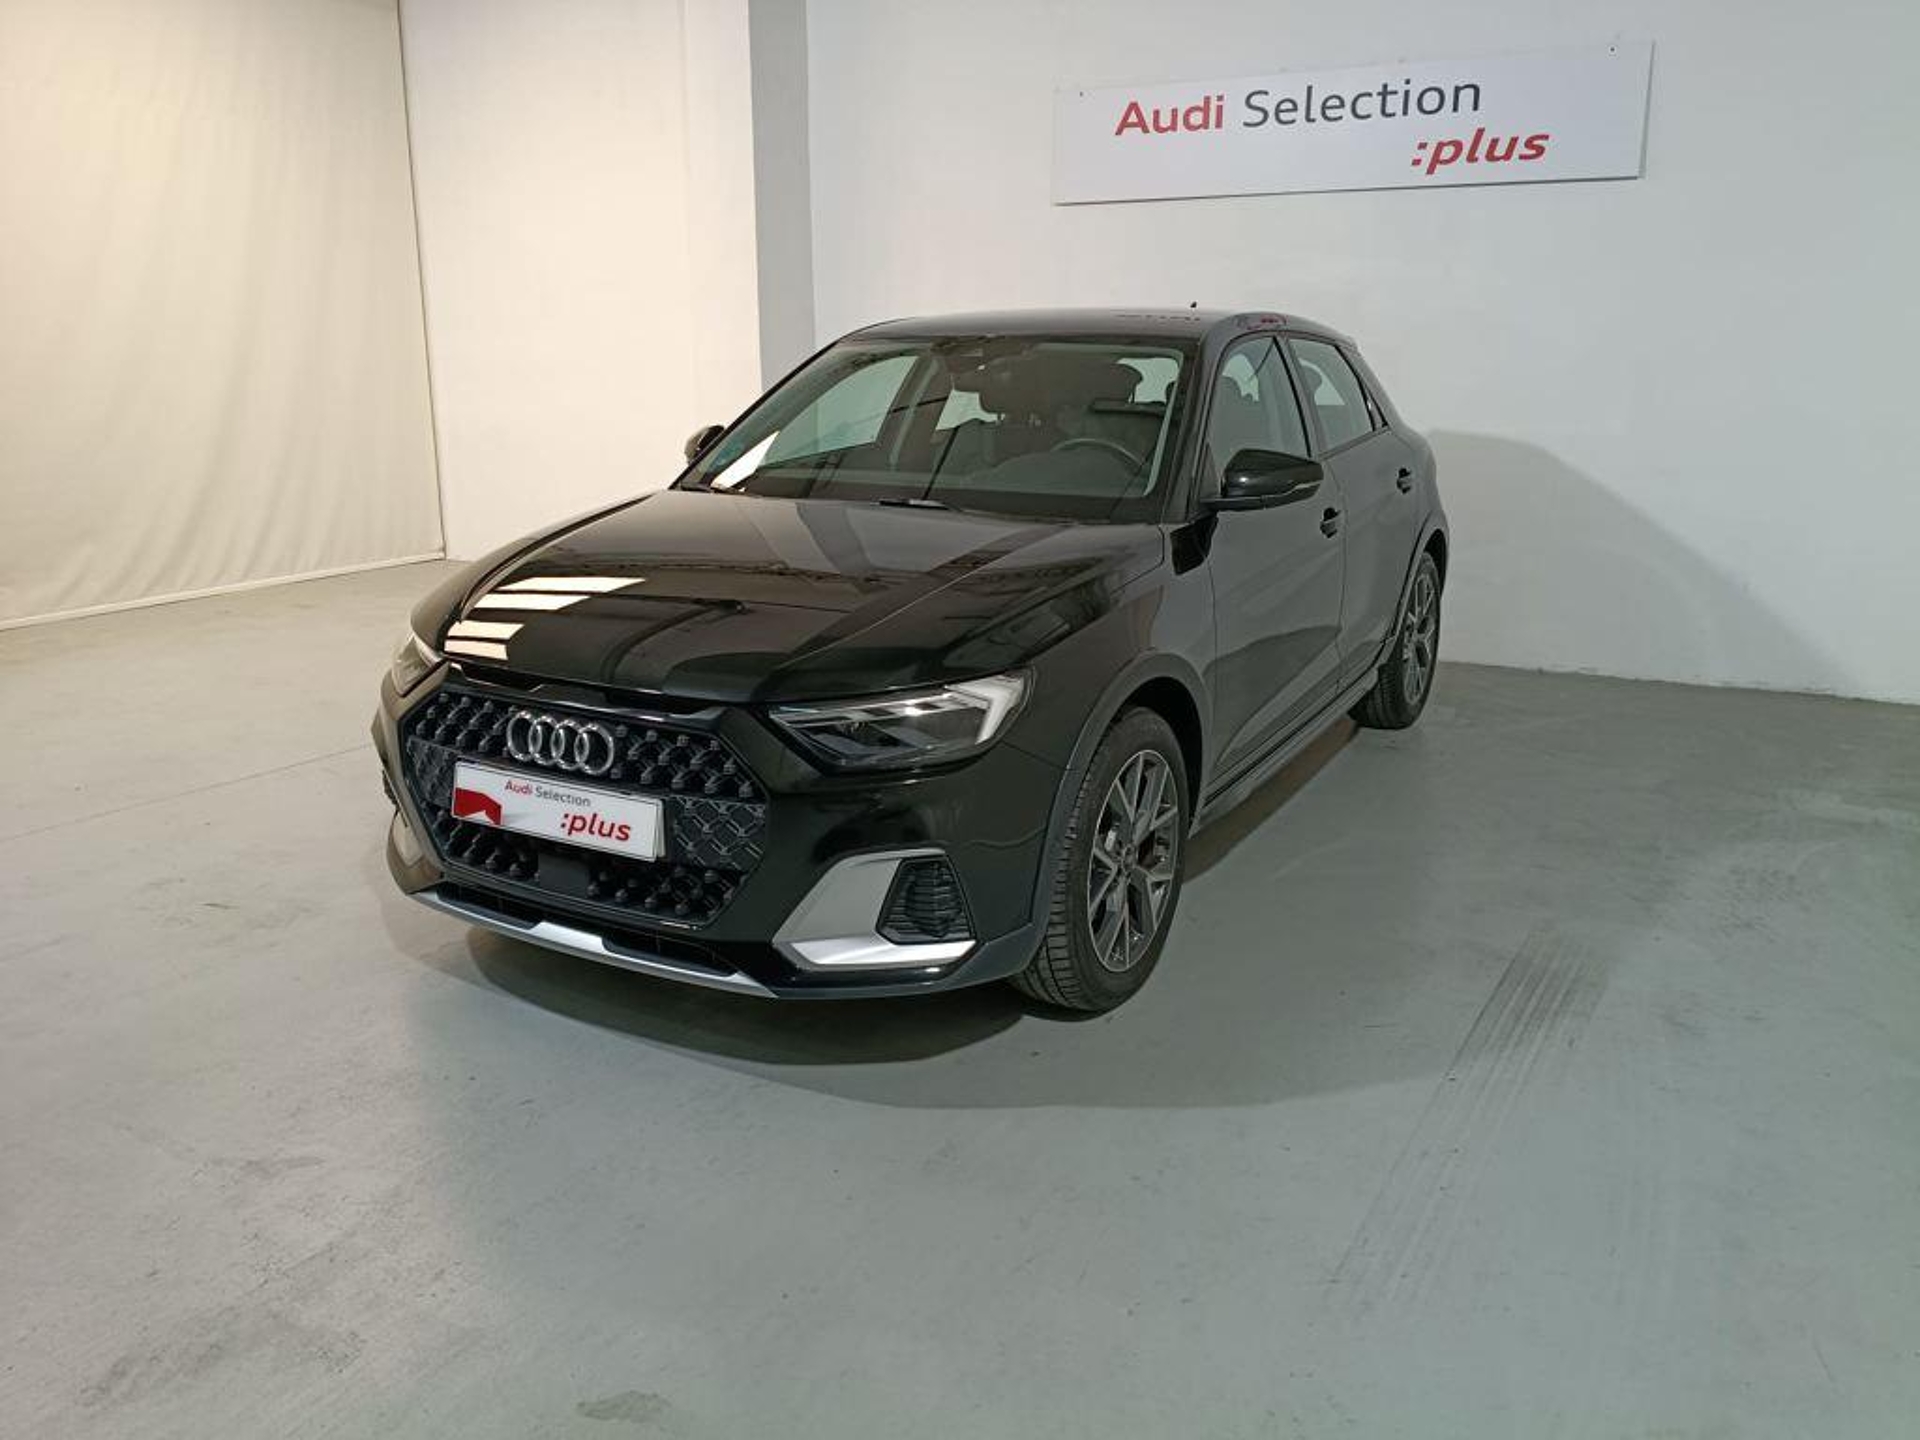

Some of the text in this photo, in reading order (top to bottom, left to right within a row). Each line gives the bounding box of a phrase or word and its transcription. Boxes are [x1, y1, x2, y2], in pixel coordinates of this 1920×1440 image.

[1115, 78, 1481, 135] Audi Selection
[1411, 128, 1549, 174] :plus
[504, 780, 591, 807] Audi Selection
[560, 812, 631, 841] :plus
